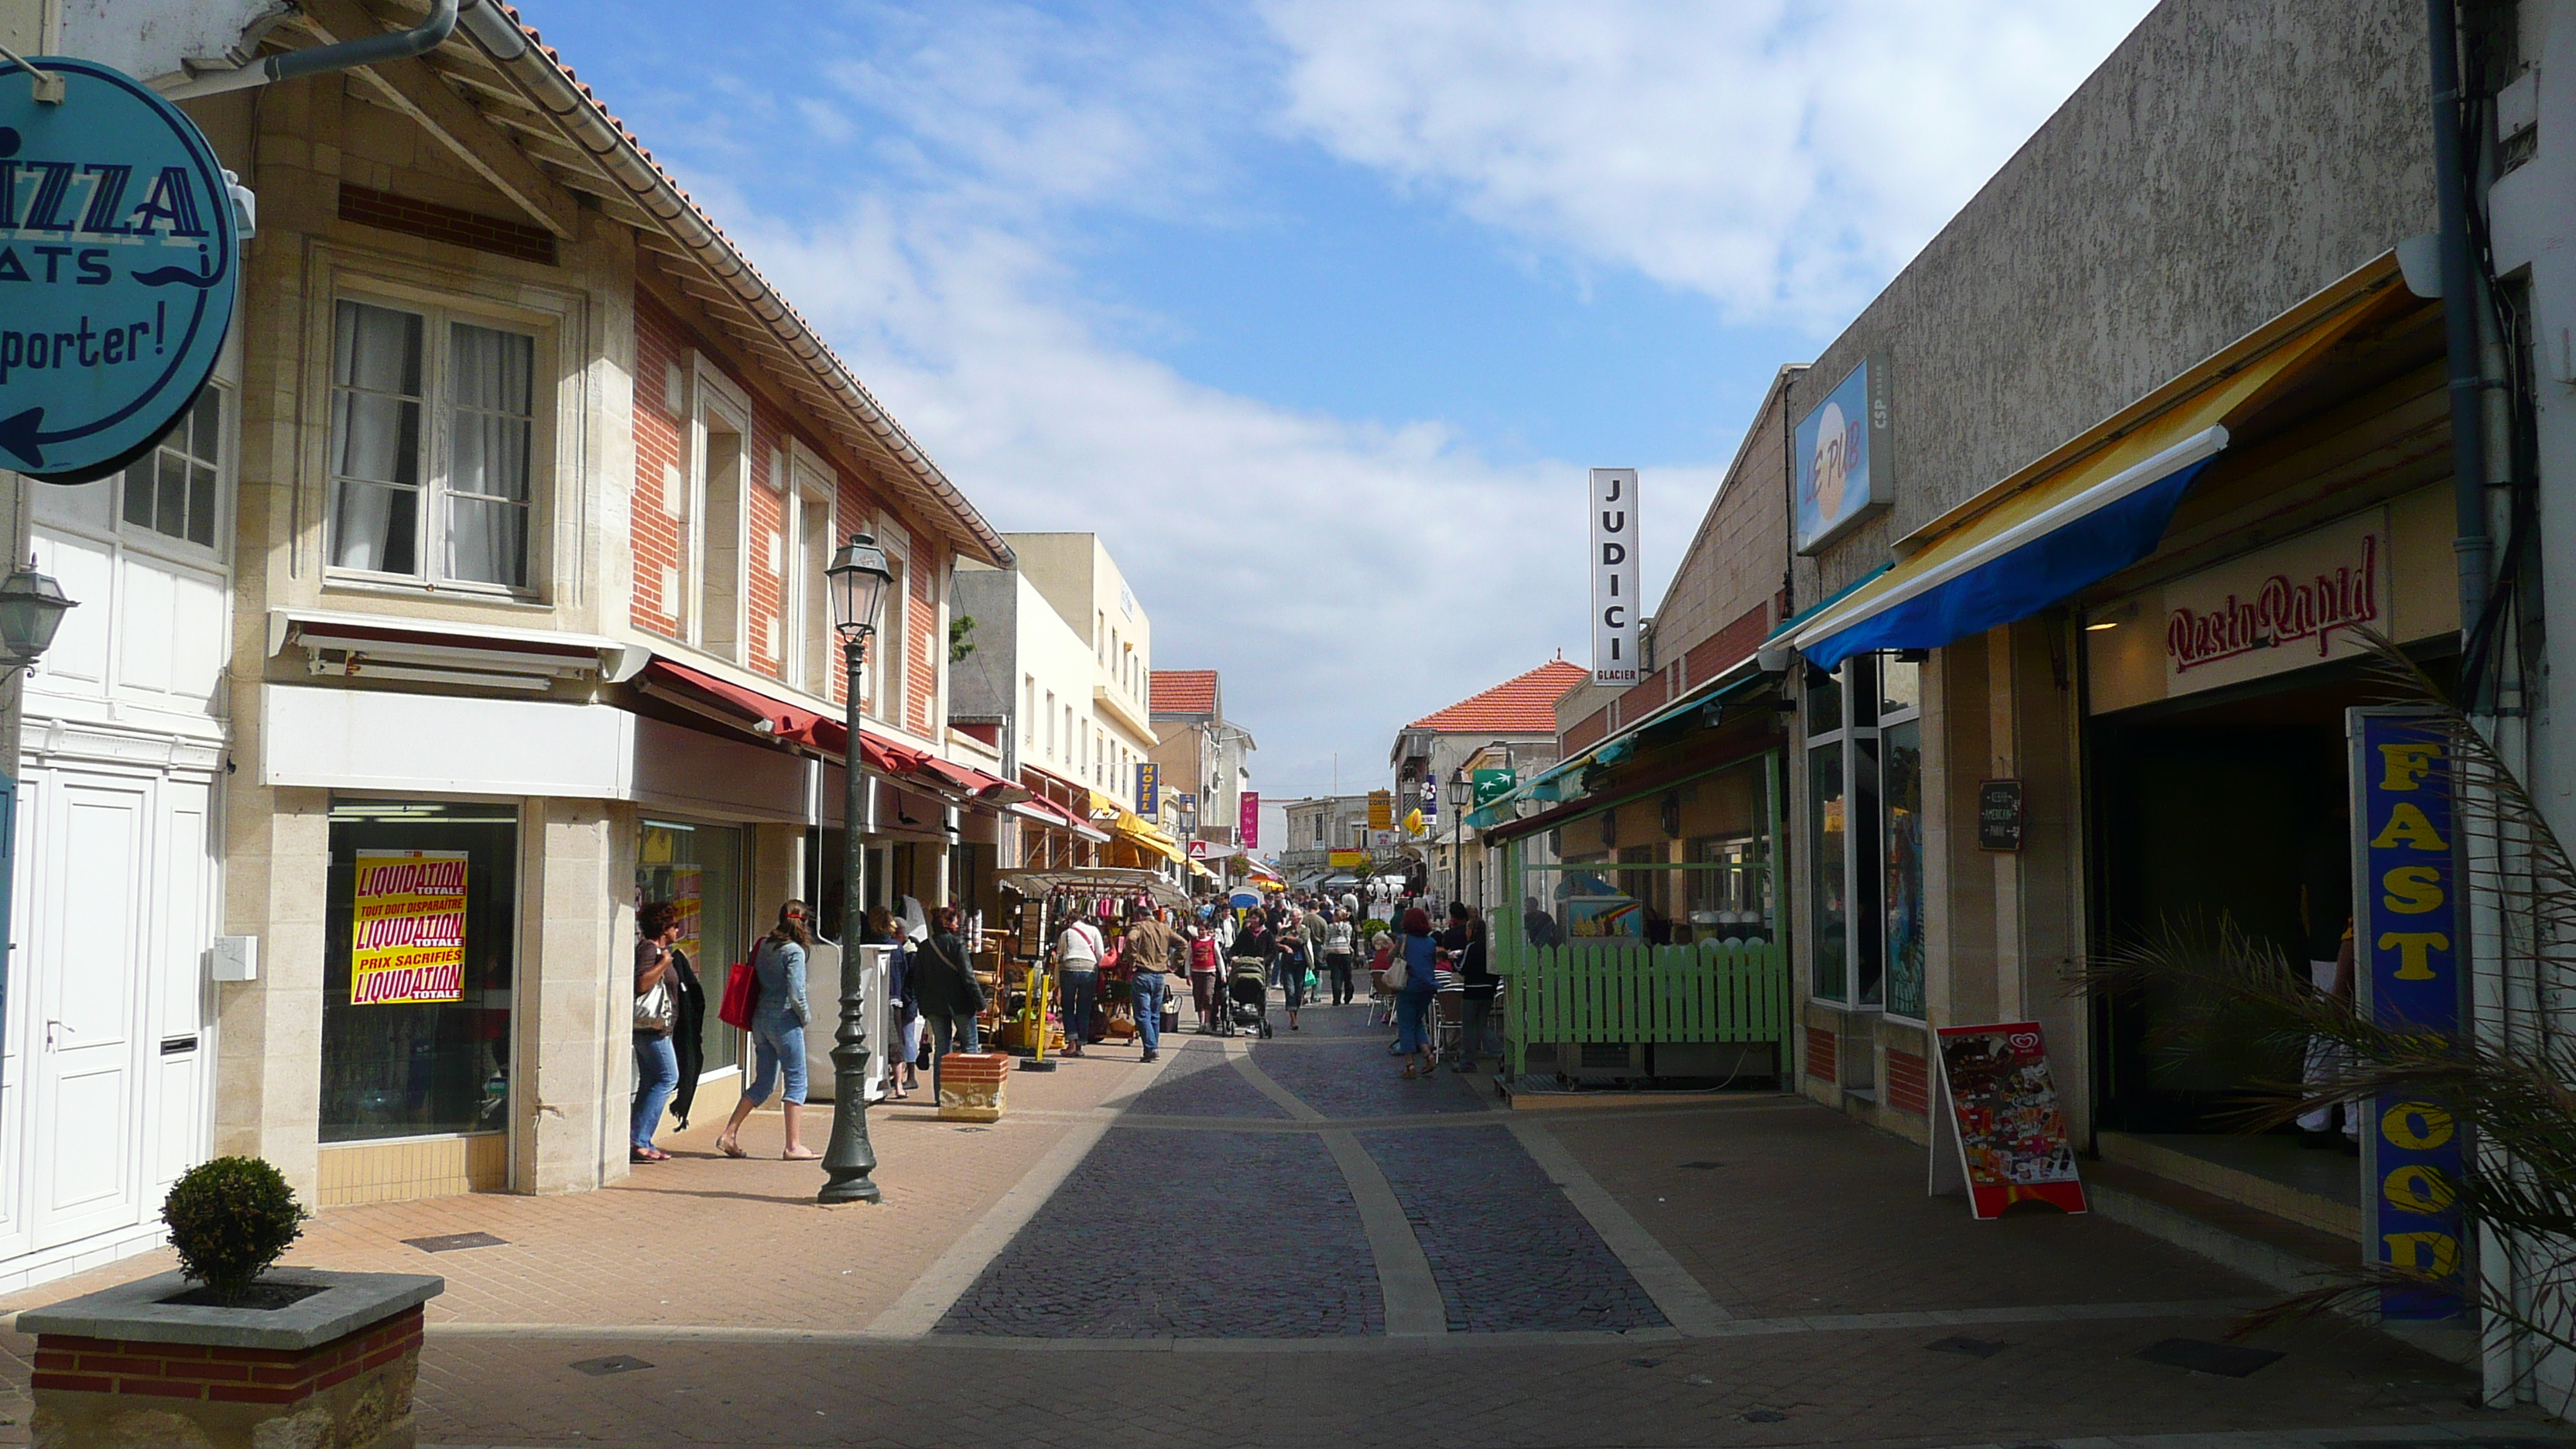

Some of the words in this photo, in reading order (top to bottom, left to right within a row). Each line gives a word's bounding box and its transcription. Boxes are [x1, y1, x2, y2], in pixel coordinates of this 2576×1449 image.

[1828, 420, 1861, 488] PUB
[1602, 480, 1626, 660] JUDICI
[1598, 670, 1636, 680] GLACIER
[1142, 766, 1154, 810] HOTEL
[357, 861, 467, 899] LIQUIDATION
[2369, 743, 2450, 981] FAST
[361, 904, 383, 916] TOUT
[385, 903, 405, 914] DOIT
[406, 898, 463, 913] DISPARAÎTRE
[416, 886, 464, 896] TOTALE
[355, 912, 465, 951] LIQUIDATION
[414, 938, 462, 947] TOTALE
[359, 957, 391, 970] PRIX
[395, 948, 462, 967] SACRIFIÉS
[354, 963, 464, 1005] LIQUIDATION
[412, 989, 461, 999] TOTALE
[2379, 1033, 2460, 1279] OOD
